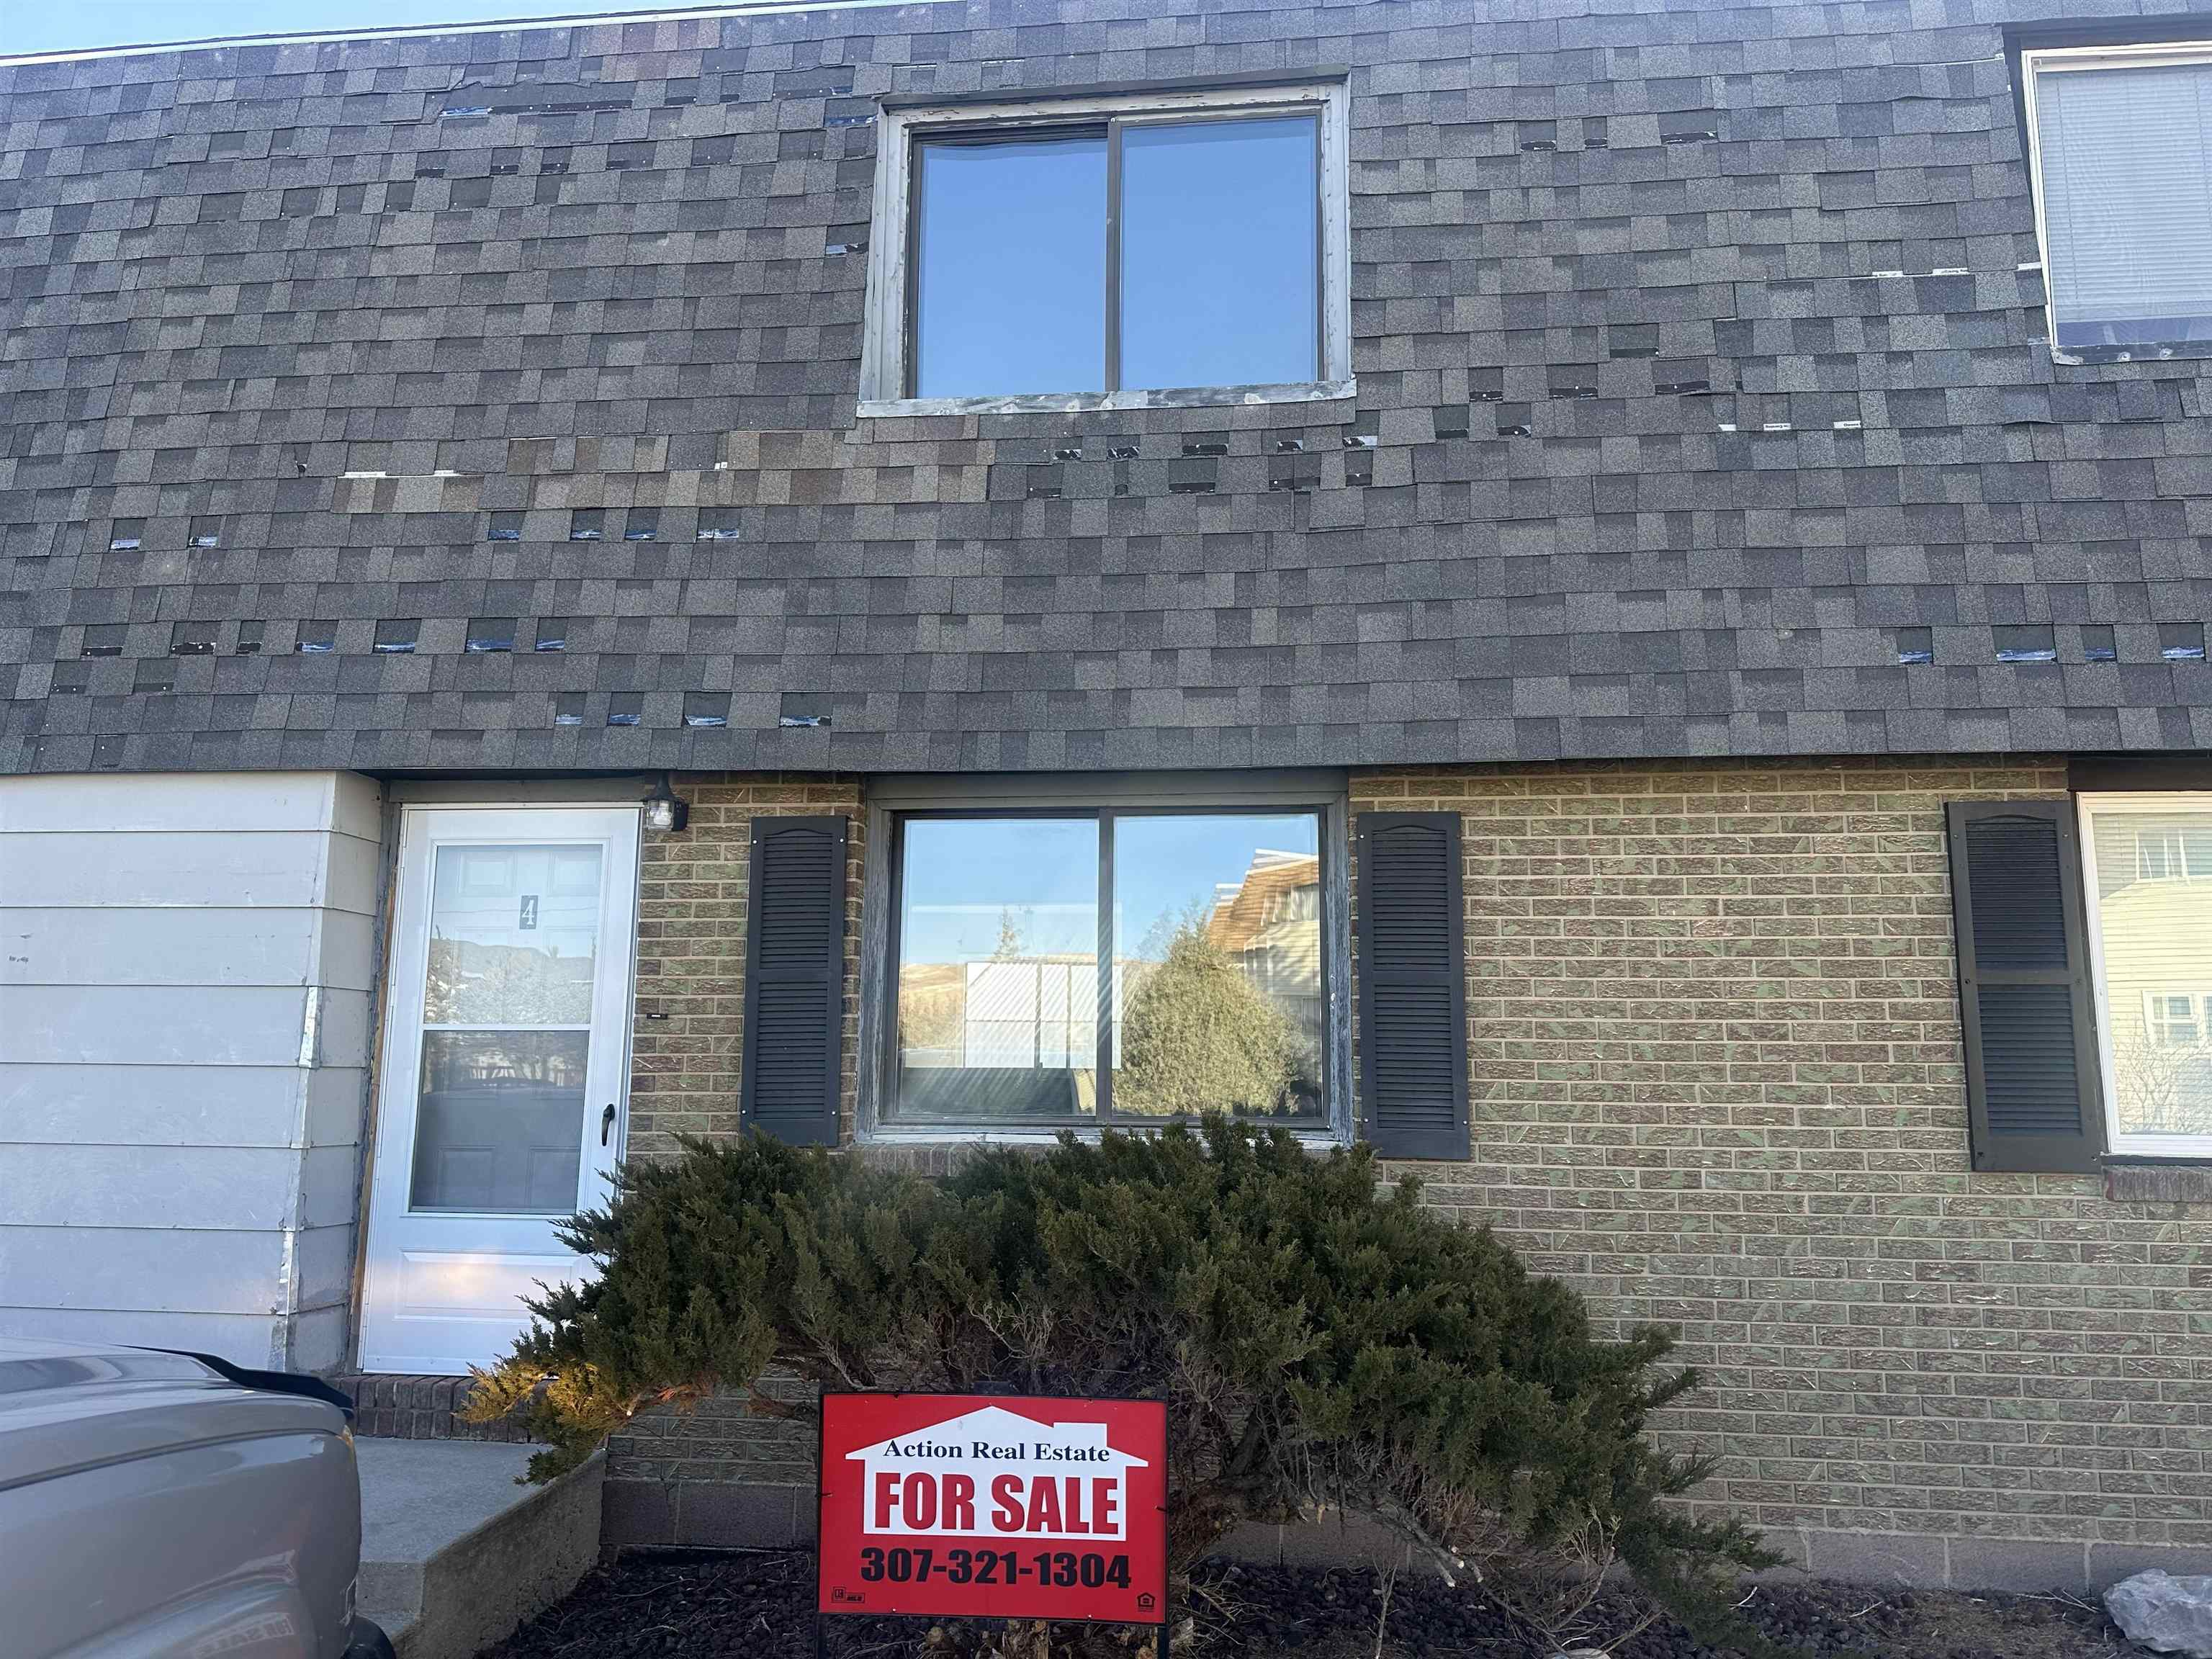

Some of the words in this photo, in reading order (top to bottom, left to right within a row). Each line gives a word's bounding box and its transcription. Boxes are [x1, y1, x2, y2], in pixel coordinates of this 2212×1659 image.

[522, 899, 535, 925] 4
[883, 1439, 963, 1459] Action
[971, 1441, 1025, 1460] Real
[1033, 1443, 1110, 1462] Estate
[874, 1472, 976, 1531] FOR
[990, 1473, 1119, 1535] SALE
[860, 1546, 1133, 1590] 307-321-1304
